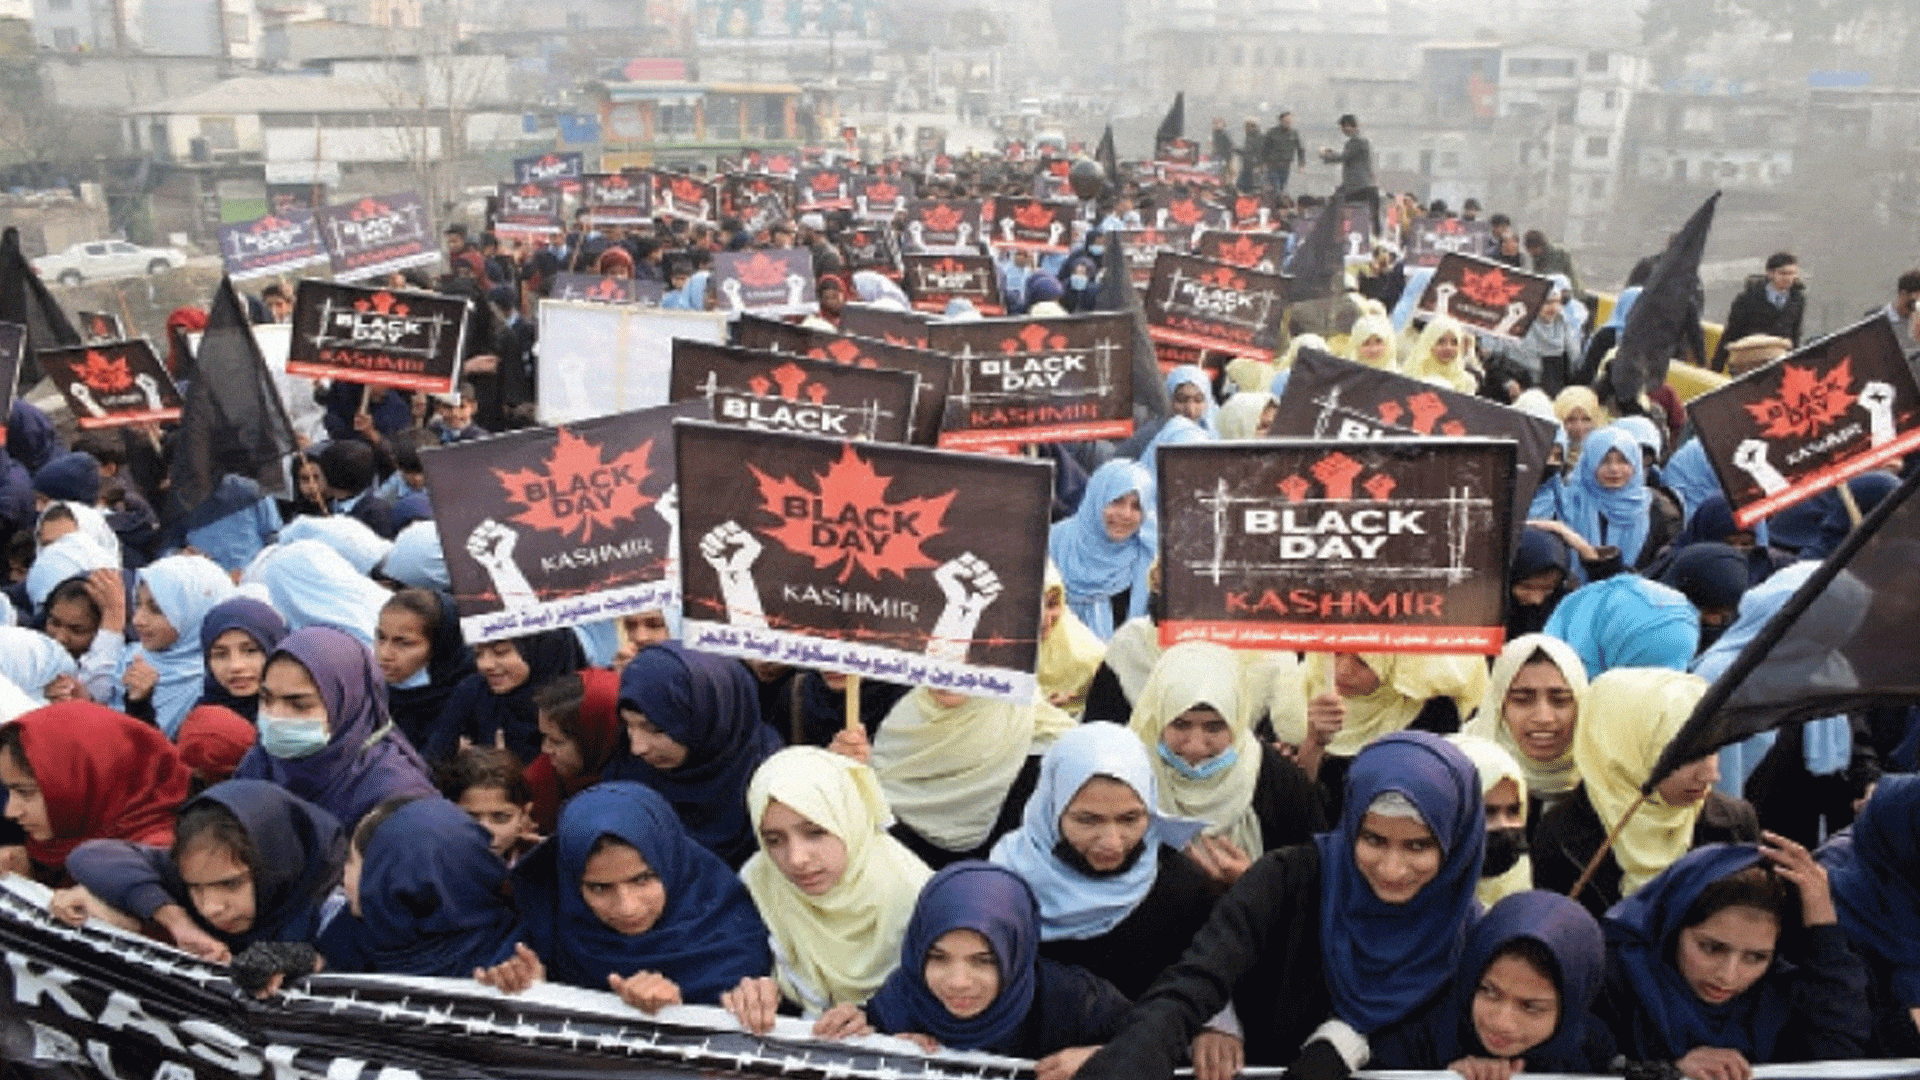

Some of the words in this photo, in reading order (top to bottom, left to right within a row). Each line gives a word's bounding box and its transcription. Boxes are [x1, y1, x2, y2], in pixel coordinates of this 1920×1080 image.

[336, 313, 421, 335] BLACK
[980, 354, 1087, 375] BLACK
[1002, 370, 1065, 391] DAY
[722, 398, 848, 433] BLACK
[524, 464, 636, 502] BLACK
[551, 489, 614, 518] DAY
[782, 496, 921, 537] BLACK
[1244, 509, 1427, 535] BLACK
[540, 537, 654, 572] KASHMIR
[811, 523, 891, 556] DAY
[1279, 535, 1388, 560] DAY
[783, 583, 920, 623] KASHMIR
[1224, 589, 1446, 619] KASHMIR
